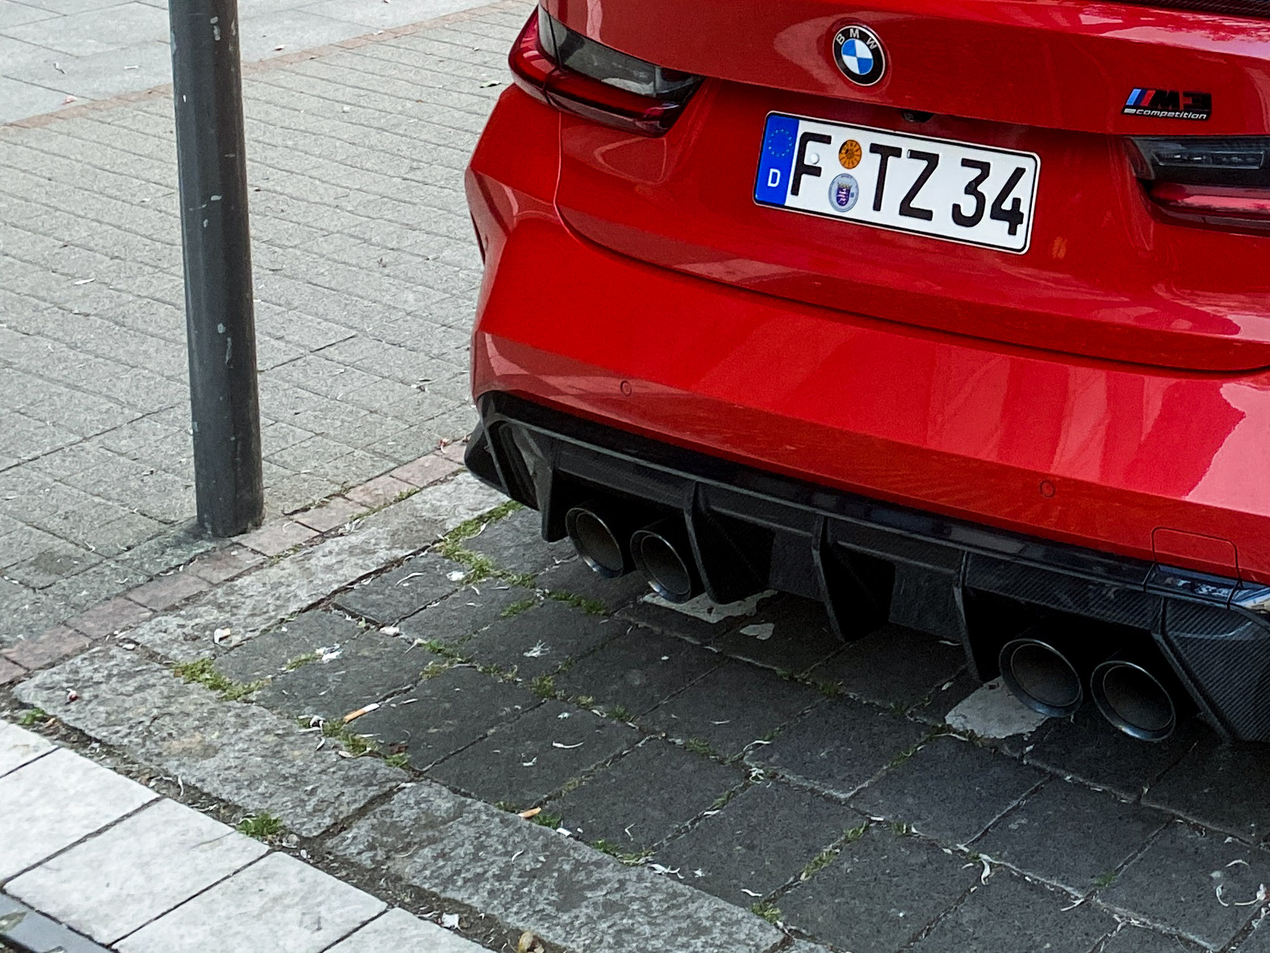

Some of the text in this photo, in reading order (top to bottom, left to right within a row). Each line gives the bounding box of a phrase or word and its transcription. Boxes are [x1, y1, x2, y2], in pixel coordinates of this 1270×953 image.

[1135, 108, 1207, 120] competition
[767, 169, 780, 188] D
[790, 131, 1026, 236] F TZ 34
